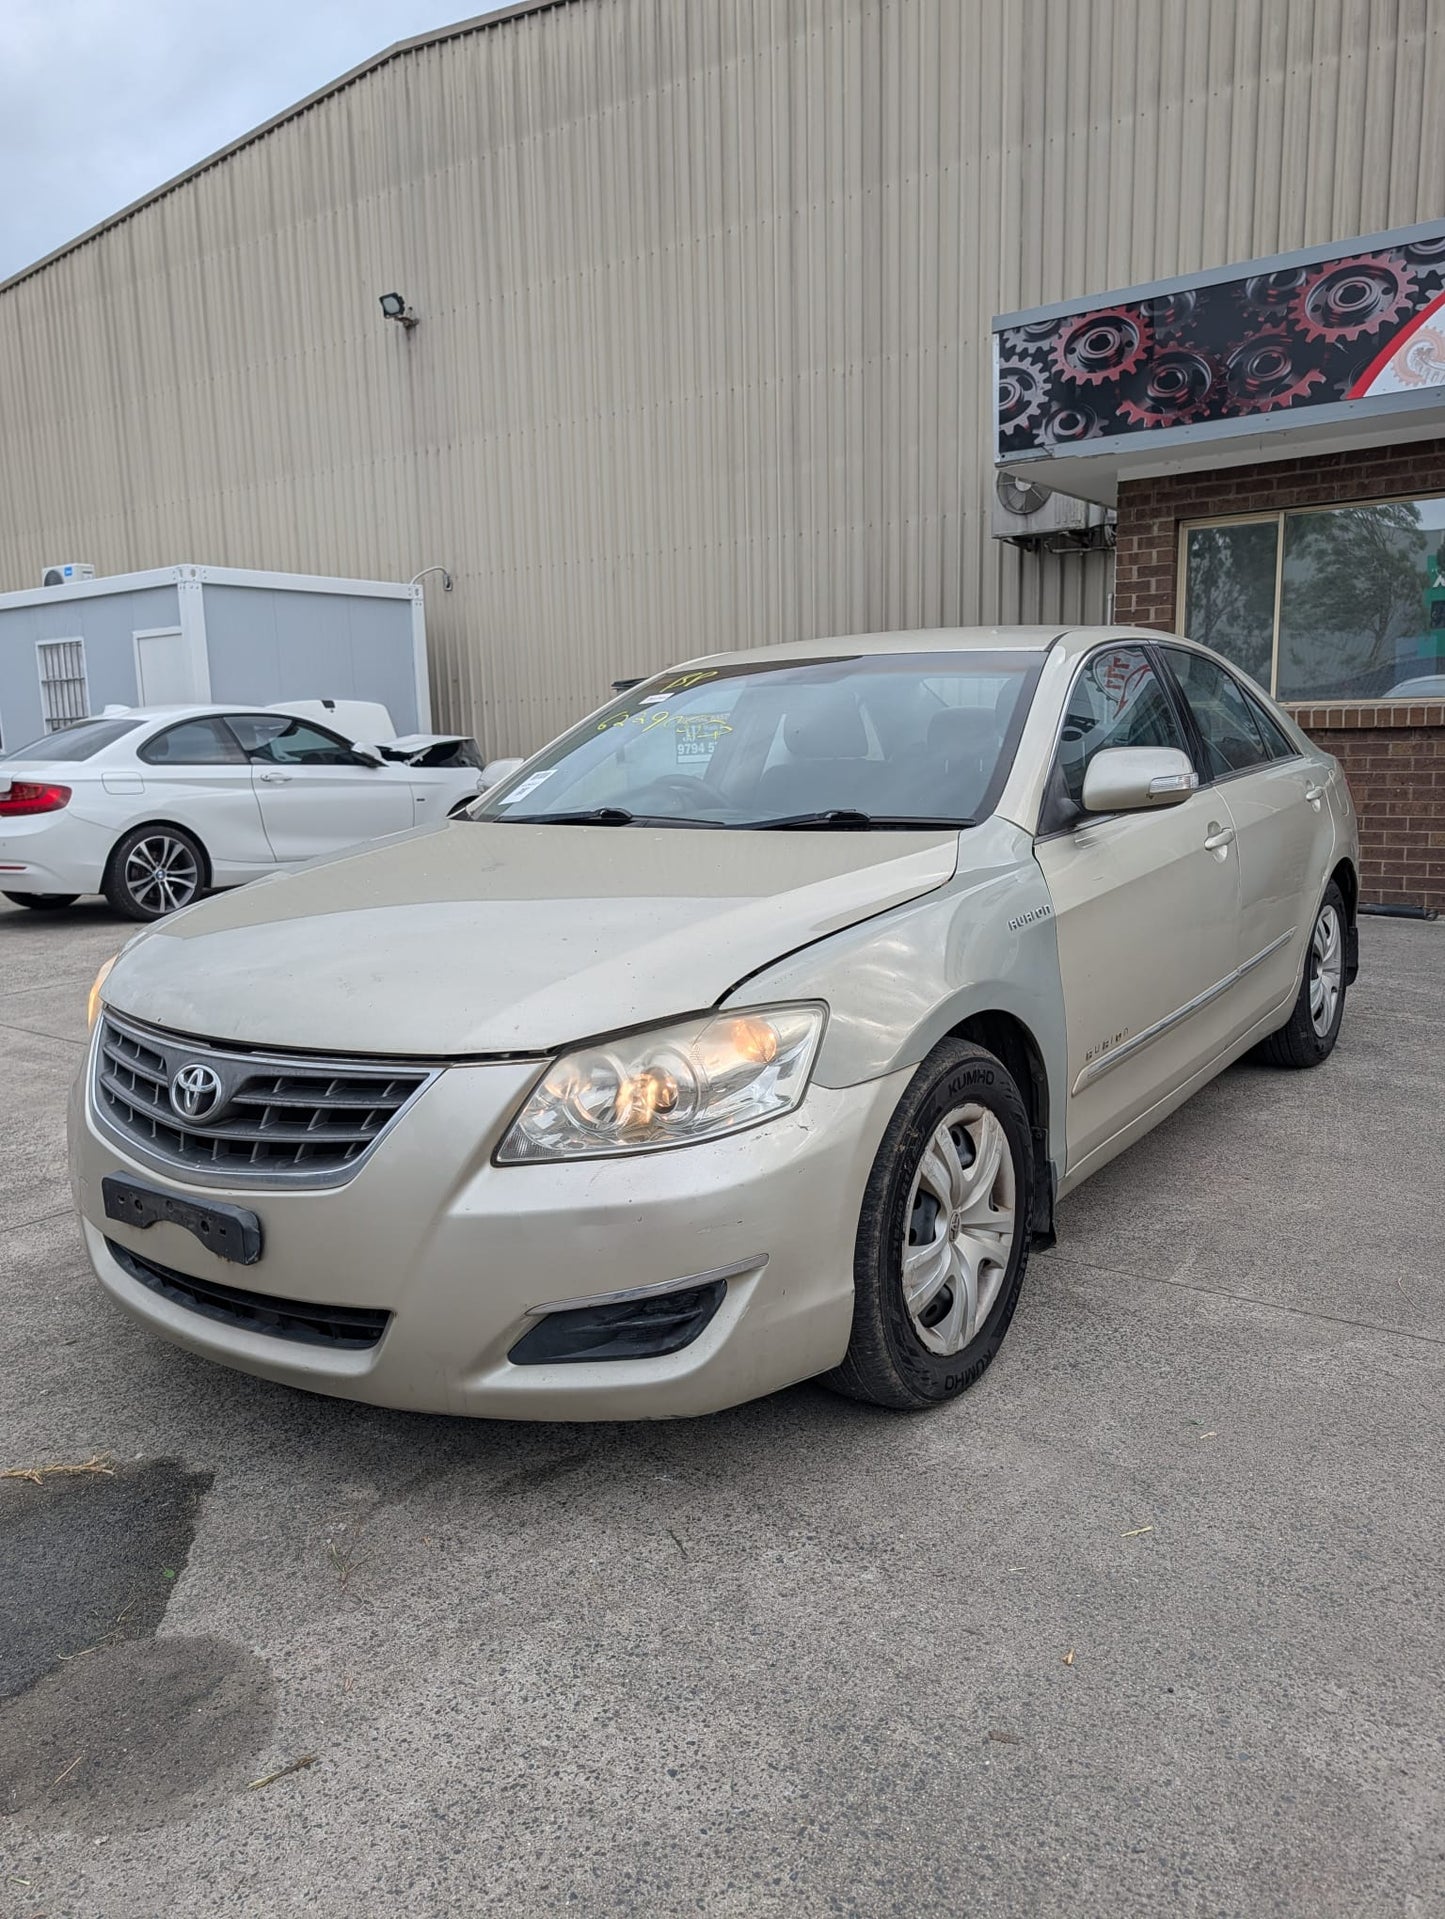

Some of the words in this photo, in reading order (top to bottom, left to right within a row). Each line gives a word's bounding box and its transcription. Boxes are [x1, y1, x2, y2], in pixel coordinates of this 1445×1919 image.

[677, 742, 705, 755] 9794
[948, 1069, 994, 1097] KUMHO
[945, 1349, 992, 1391] KUMHO
